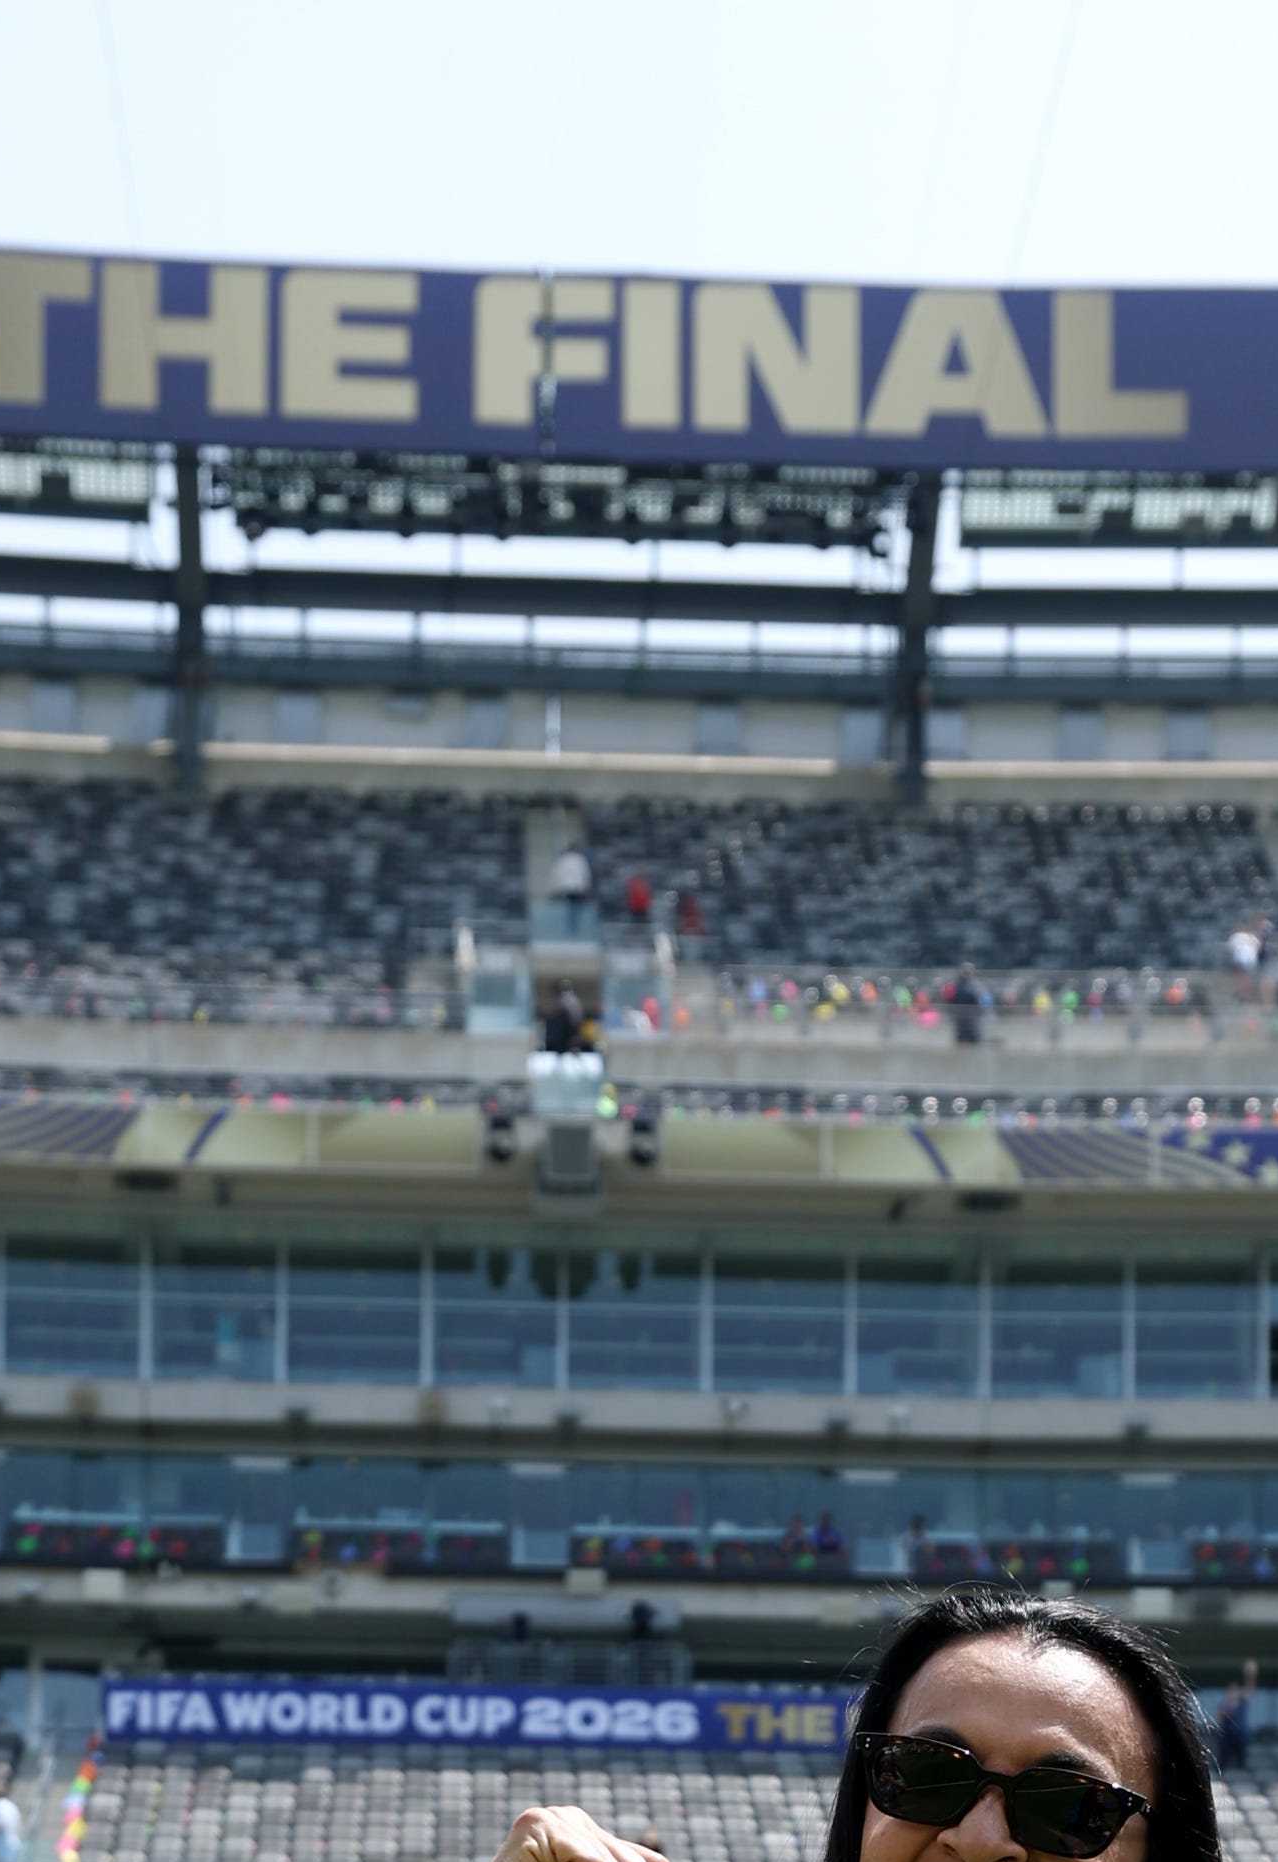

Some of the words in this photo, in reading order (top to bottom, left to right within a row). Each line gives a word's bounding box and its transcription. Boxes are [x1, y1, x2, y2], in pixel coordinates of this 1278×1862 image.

[472, 273, 1190, 437] FINAL
[107, 1689, 214, 1732] FIFA
[218, 1691, 405, 1735] WORLD
[413, 1694, 514, 1737] CUP
[520, 1698, 700, 1741] 2026
[716, 1702, 838, 1745] THE
